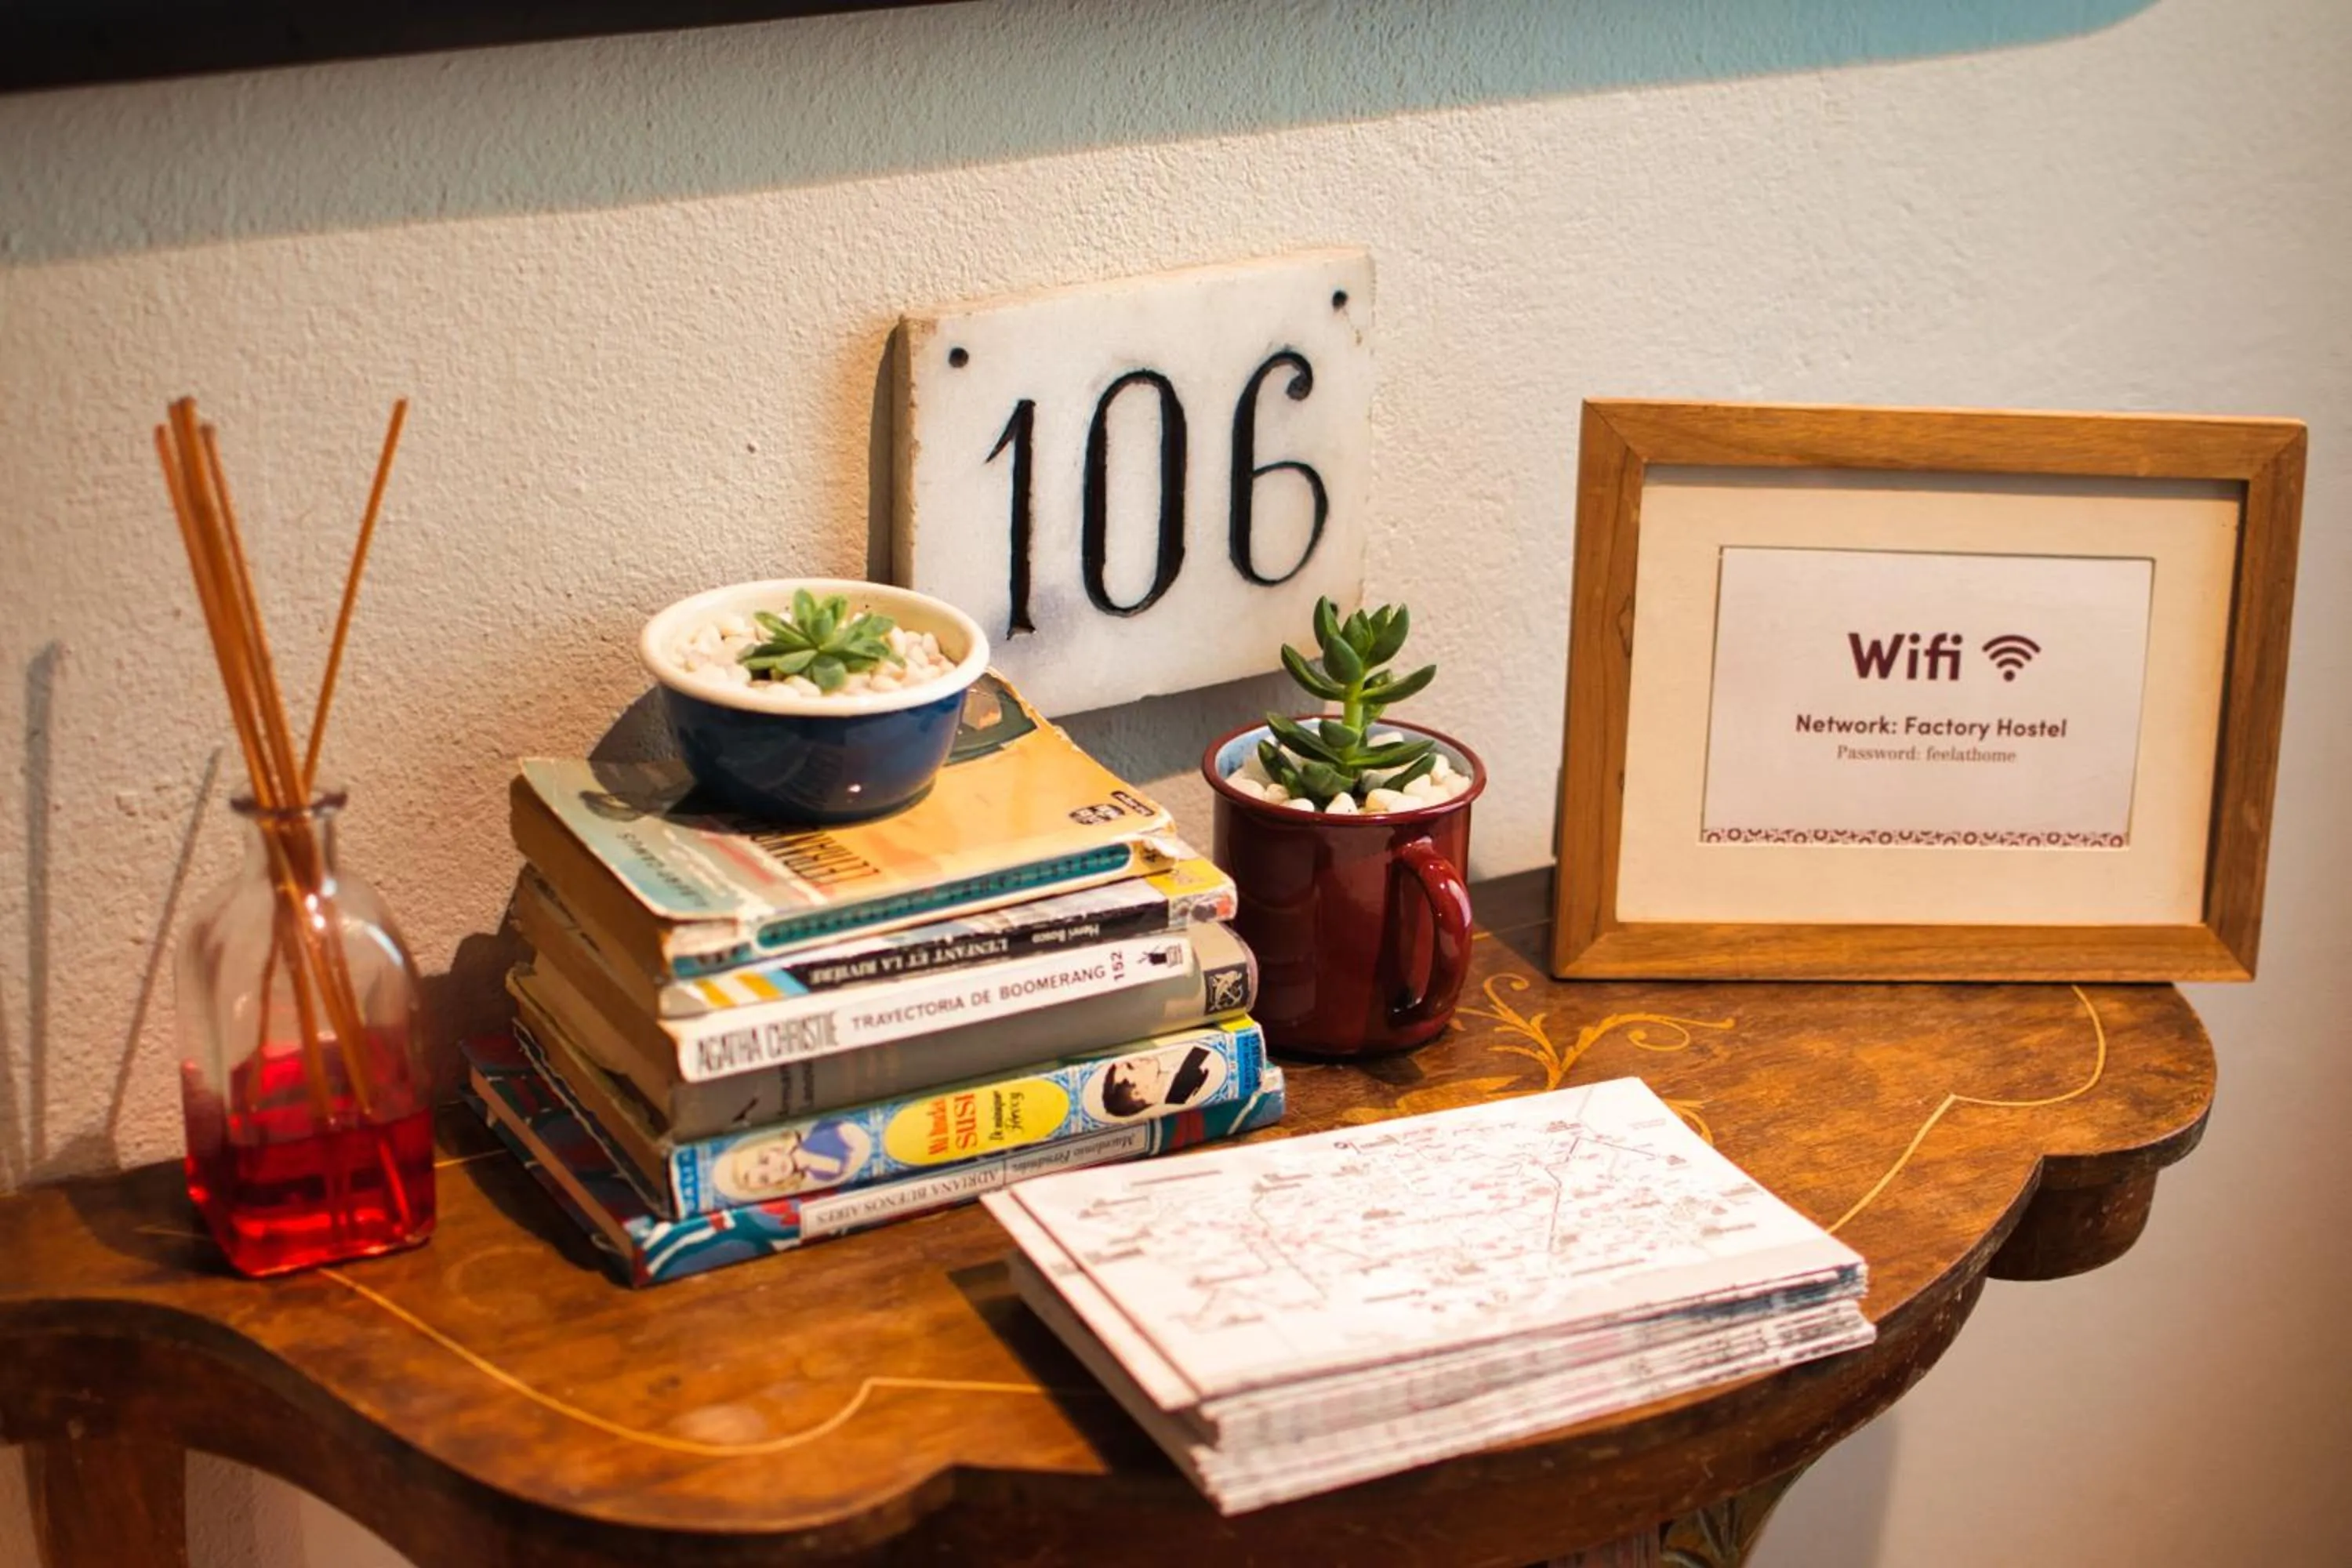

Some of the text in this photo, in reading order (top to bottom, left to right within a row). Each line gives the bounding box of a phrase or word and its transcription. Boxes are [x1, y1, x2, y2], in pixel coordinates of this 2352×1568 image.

[985, 348, 1329, 641] 106
[1848, 632, 1963, 681] Wifi
[1795, 714, 2067, 741] Network: Factory Hostel
[1837, 745, 2017, 764] Password: feelathome
[881, 956, 902, 971] LA
[908, 950, 929, 967] ET
[1109, 949, 1126, 983] 152
[852, 964, 1108, 1032] TRAYECTORIA DE BOOMERANG
[697, 1011, 839, 1076] AGATHA CHRISTIE
[954, 1093, 978, 1151] SUSI
[816, 1169, 999, 1224] ADRIANA BUENOS AIRES
